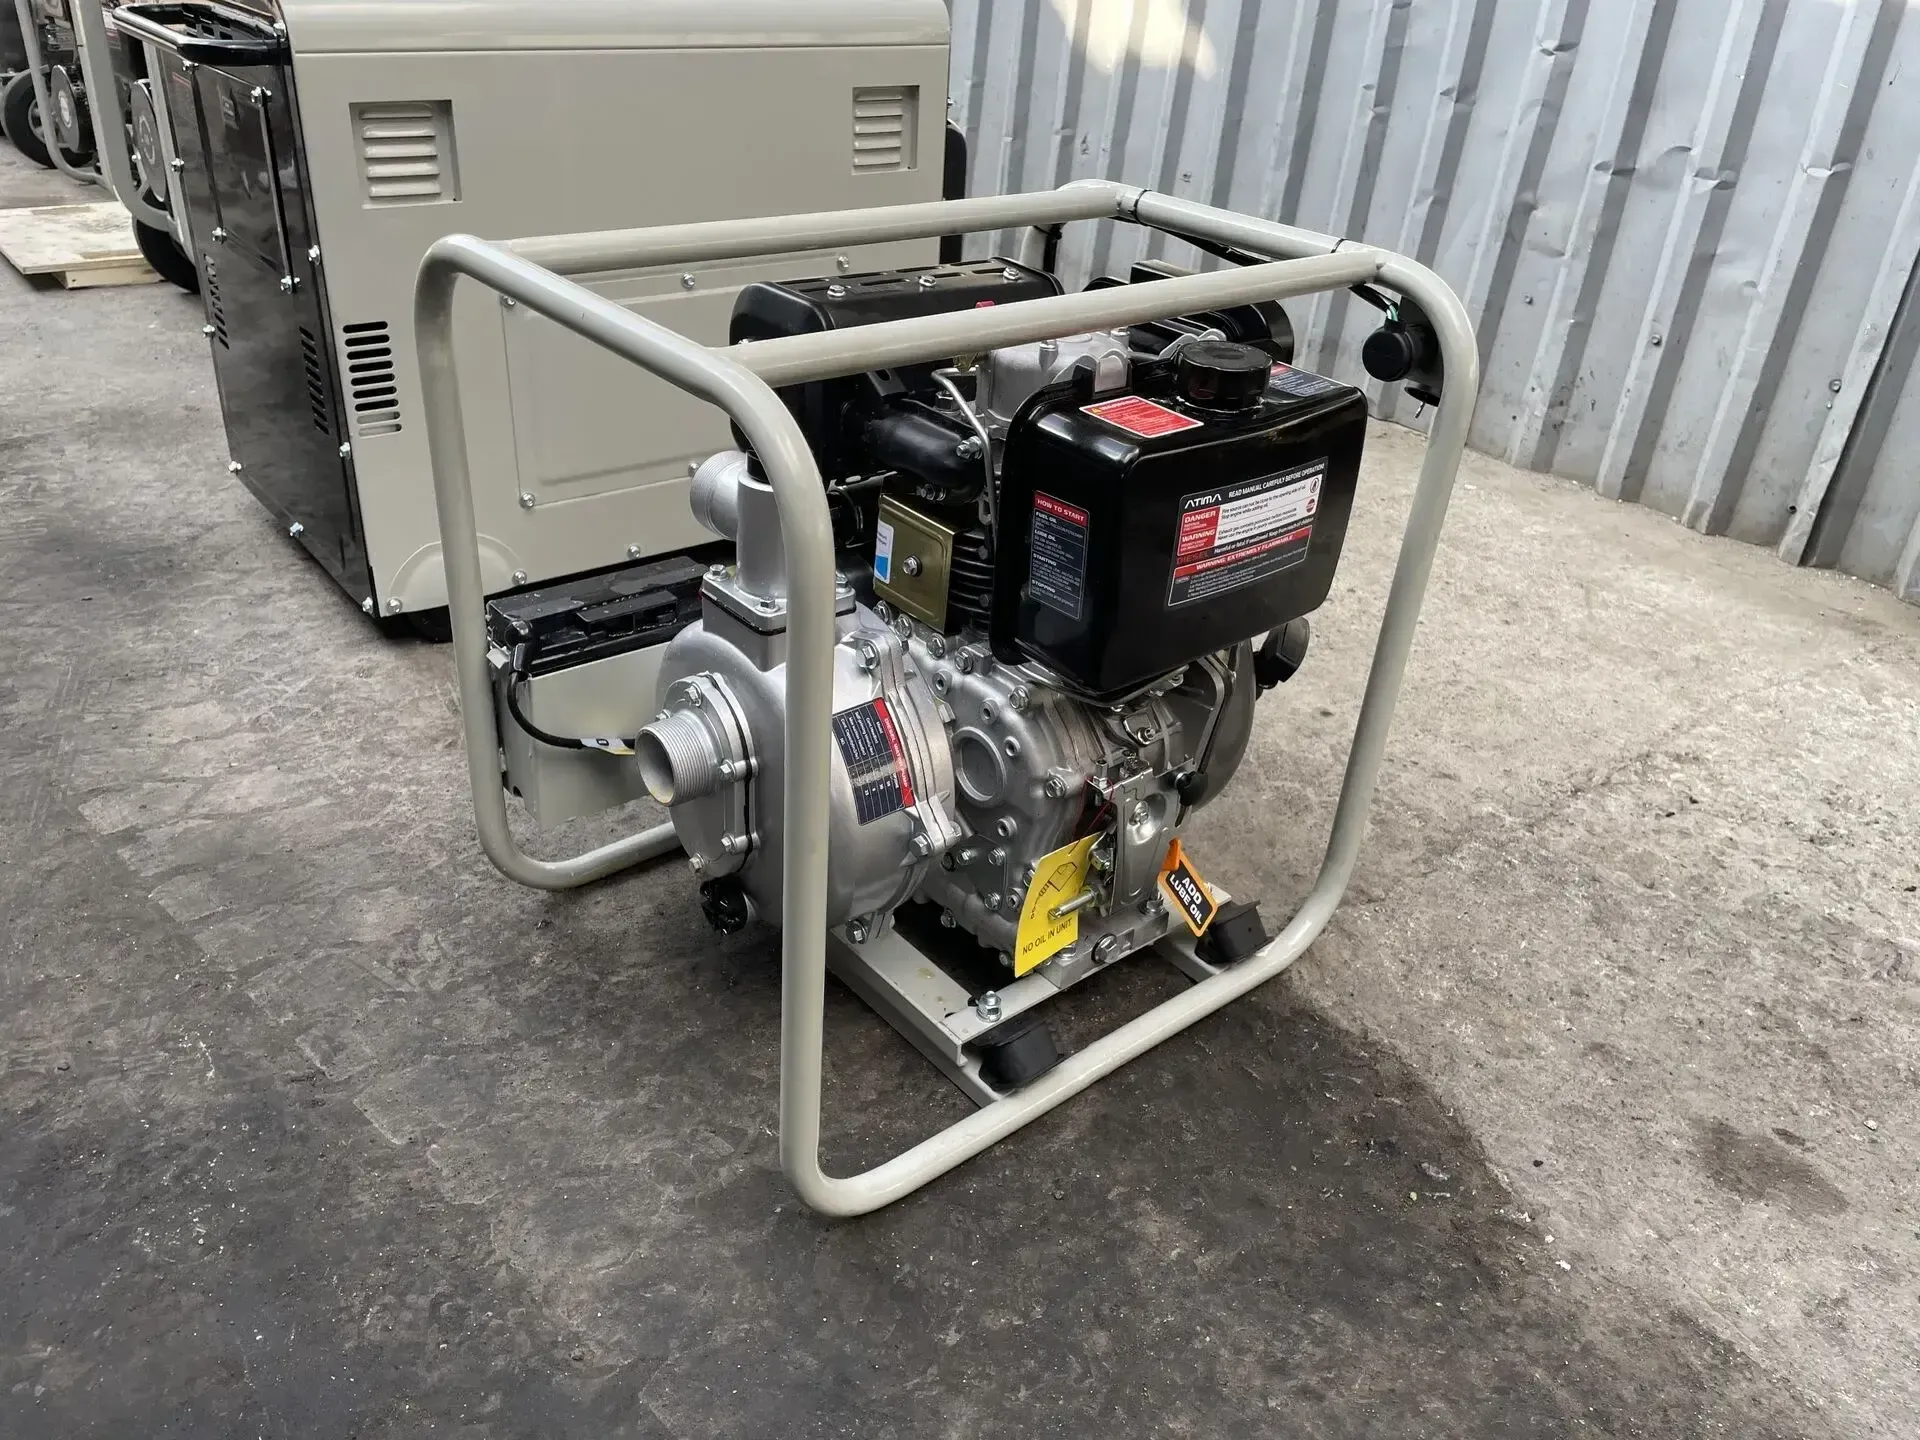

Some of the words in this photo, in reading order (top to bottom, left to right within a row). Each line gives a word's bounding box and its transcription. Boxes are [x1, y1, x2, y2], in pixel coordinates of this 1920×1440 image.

[1228, 489, 1242, 498] READ
[1242, 483, 1262, 494] MANUAL
[1285, 470, 1301, 481] BEFORE
[1184, 493, 1221, 509] ATIMA
[1037, 499, 1052, 509] HOW
[1052, 504, 1062, 513] TO
[1063, 509, 1084, 521] START
[1184, 511, 1216, 523] DANGER
[1036, 511, 1048, 520] FUEL
[1048, 516, 1057, 524] OIL
[1034, 529, 1047, 538] LUBE
[1182, 529, 1216, 542] WARNING
[1033, 552, 1056, 566] STARTING
[1032, 579, 1056, 593] STOPPING
[876, 721, 884, 734] Model
[1182, 877, 1202, 905] ADD
[1170, 874, 1191, 906] LUBE
[1190, 904, 1202, 925] OIL
[1022, 942, 1034, 955] NO
[1035, 935, 1047, 947] OIL
[1048, 928, 1055, 940] IN
[1056, 917, 1073, 934] UNIT
